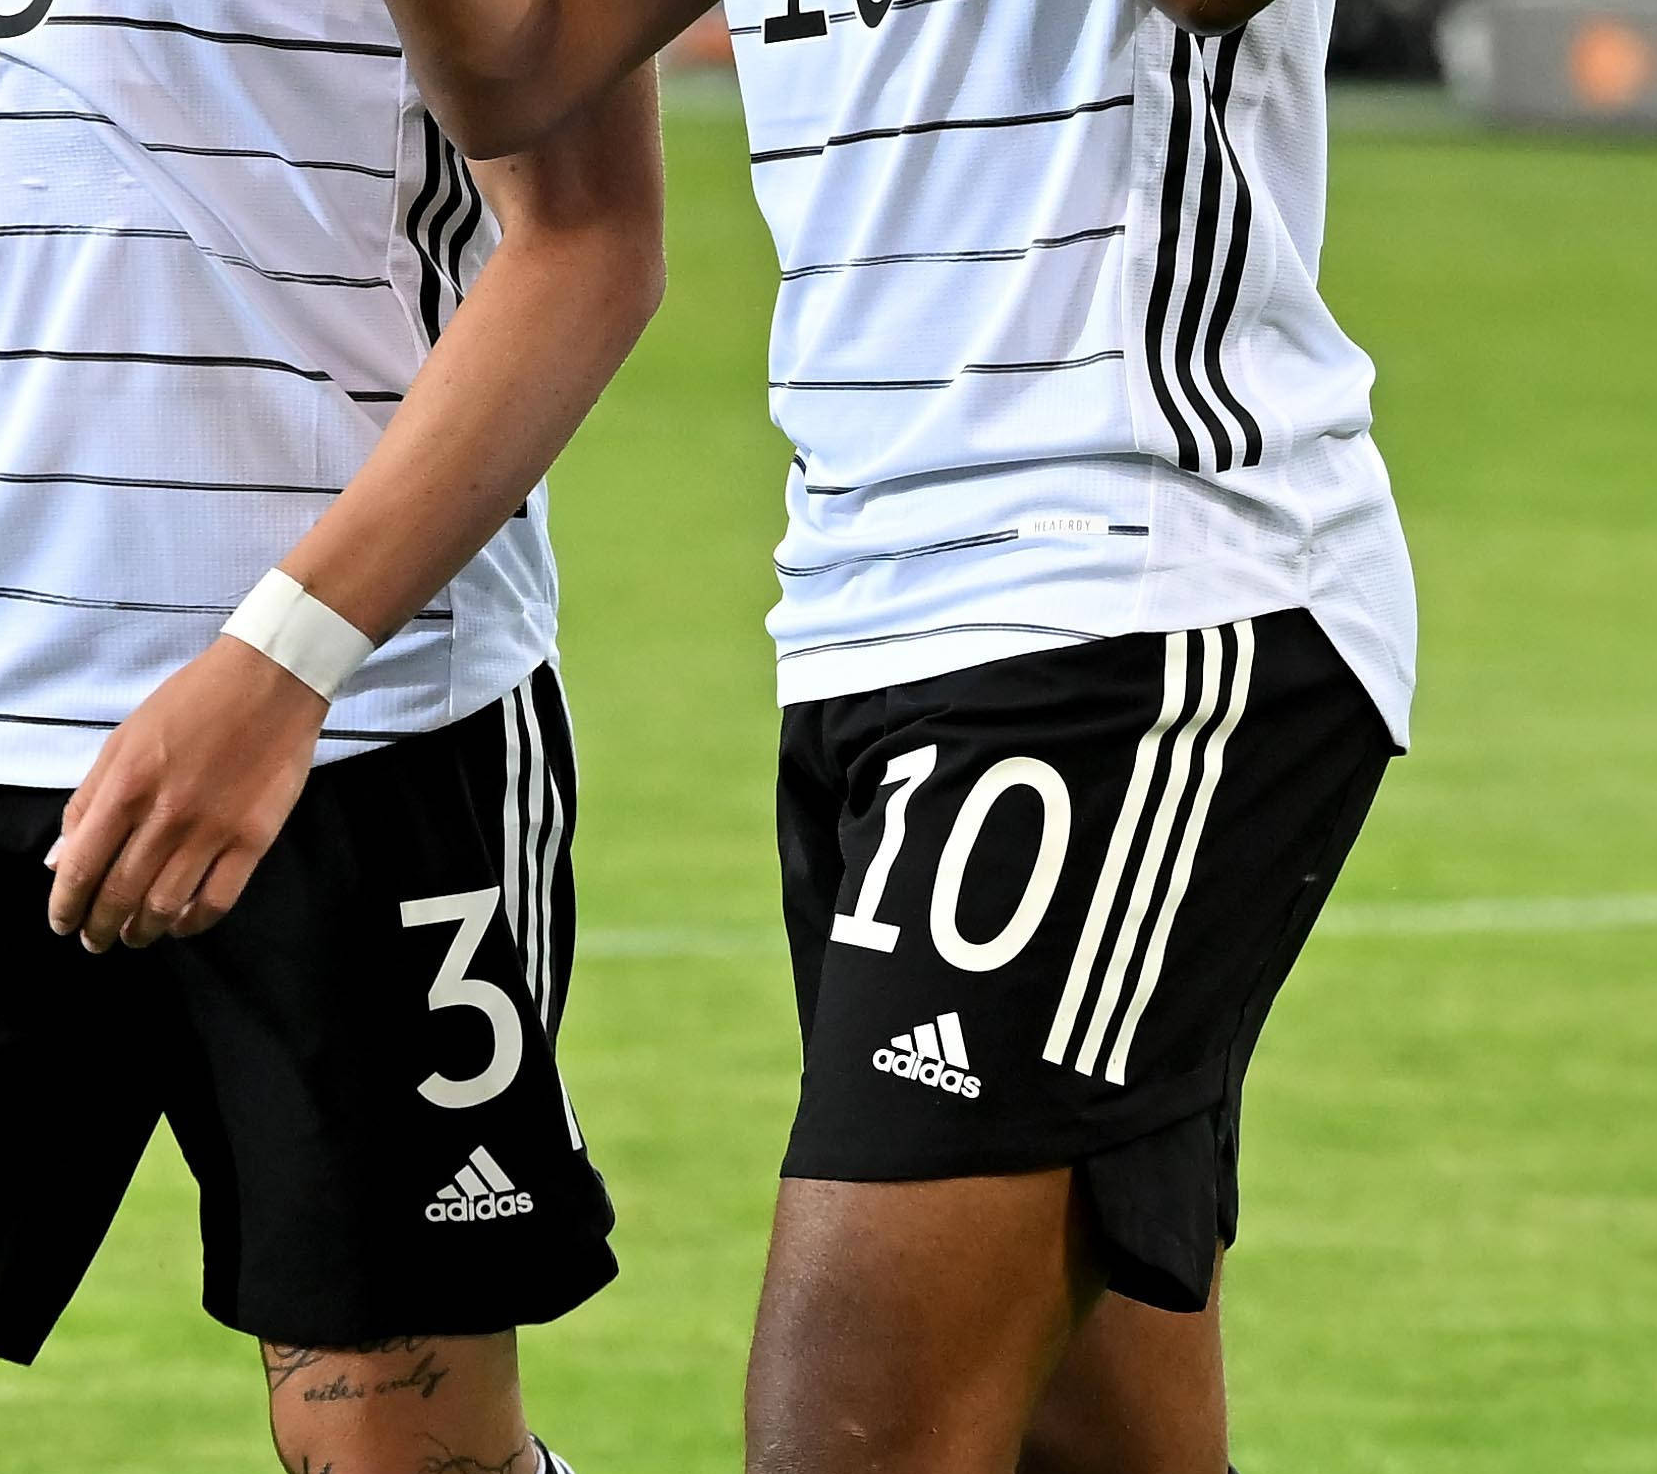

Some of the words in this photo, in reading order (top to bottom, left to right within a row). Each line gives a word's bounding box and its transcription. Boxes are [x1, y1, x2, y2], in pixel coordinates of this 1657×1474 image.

[829, 743, 1072, 973] 10
[399, 885, 523, 1109] 3
[872, 1045, 981, 1100] adidas
[425, 1191, 534, 1222] adidas
